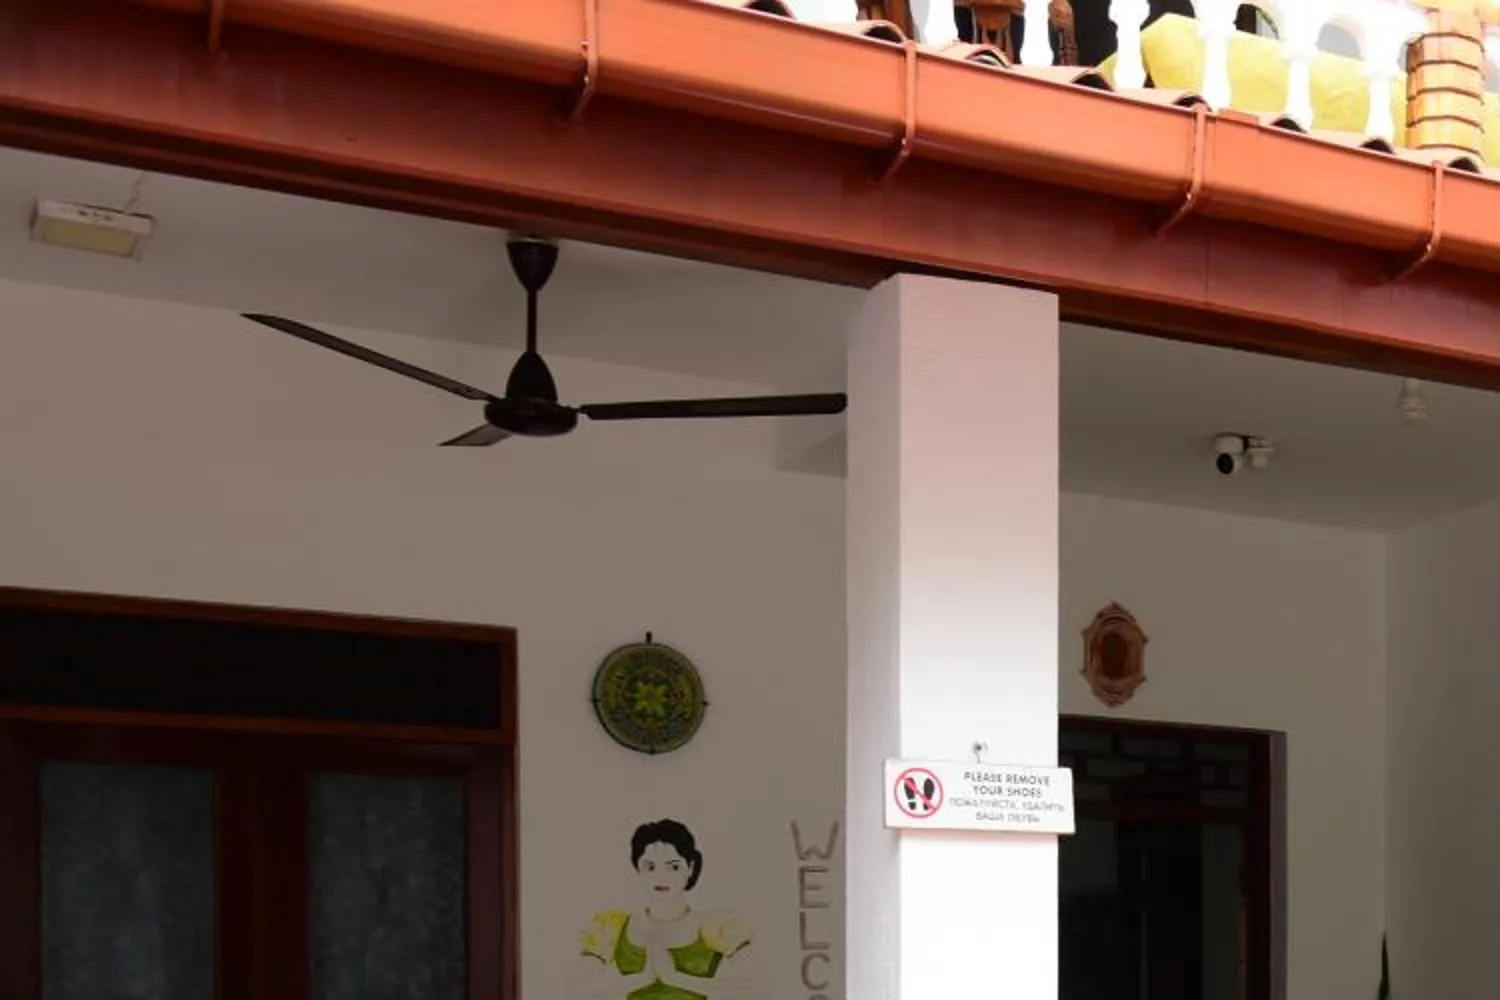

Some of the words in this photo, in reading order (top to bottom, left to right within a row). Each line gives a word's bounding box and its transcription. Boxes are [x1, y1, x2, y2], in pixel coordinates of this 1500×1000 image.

[964, 771, 1003, 783] PLEASE
[1005, 773, 1050, 786] REMOVE
[973, 785, 1002, 795] YOUR
[1007, 787, 1041, 798] SHOES
